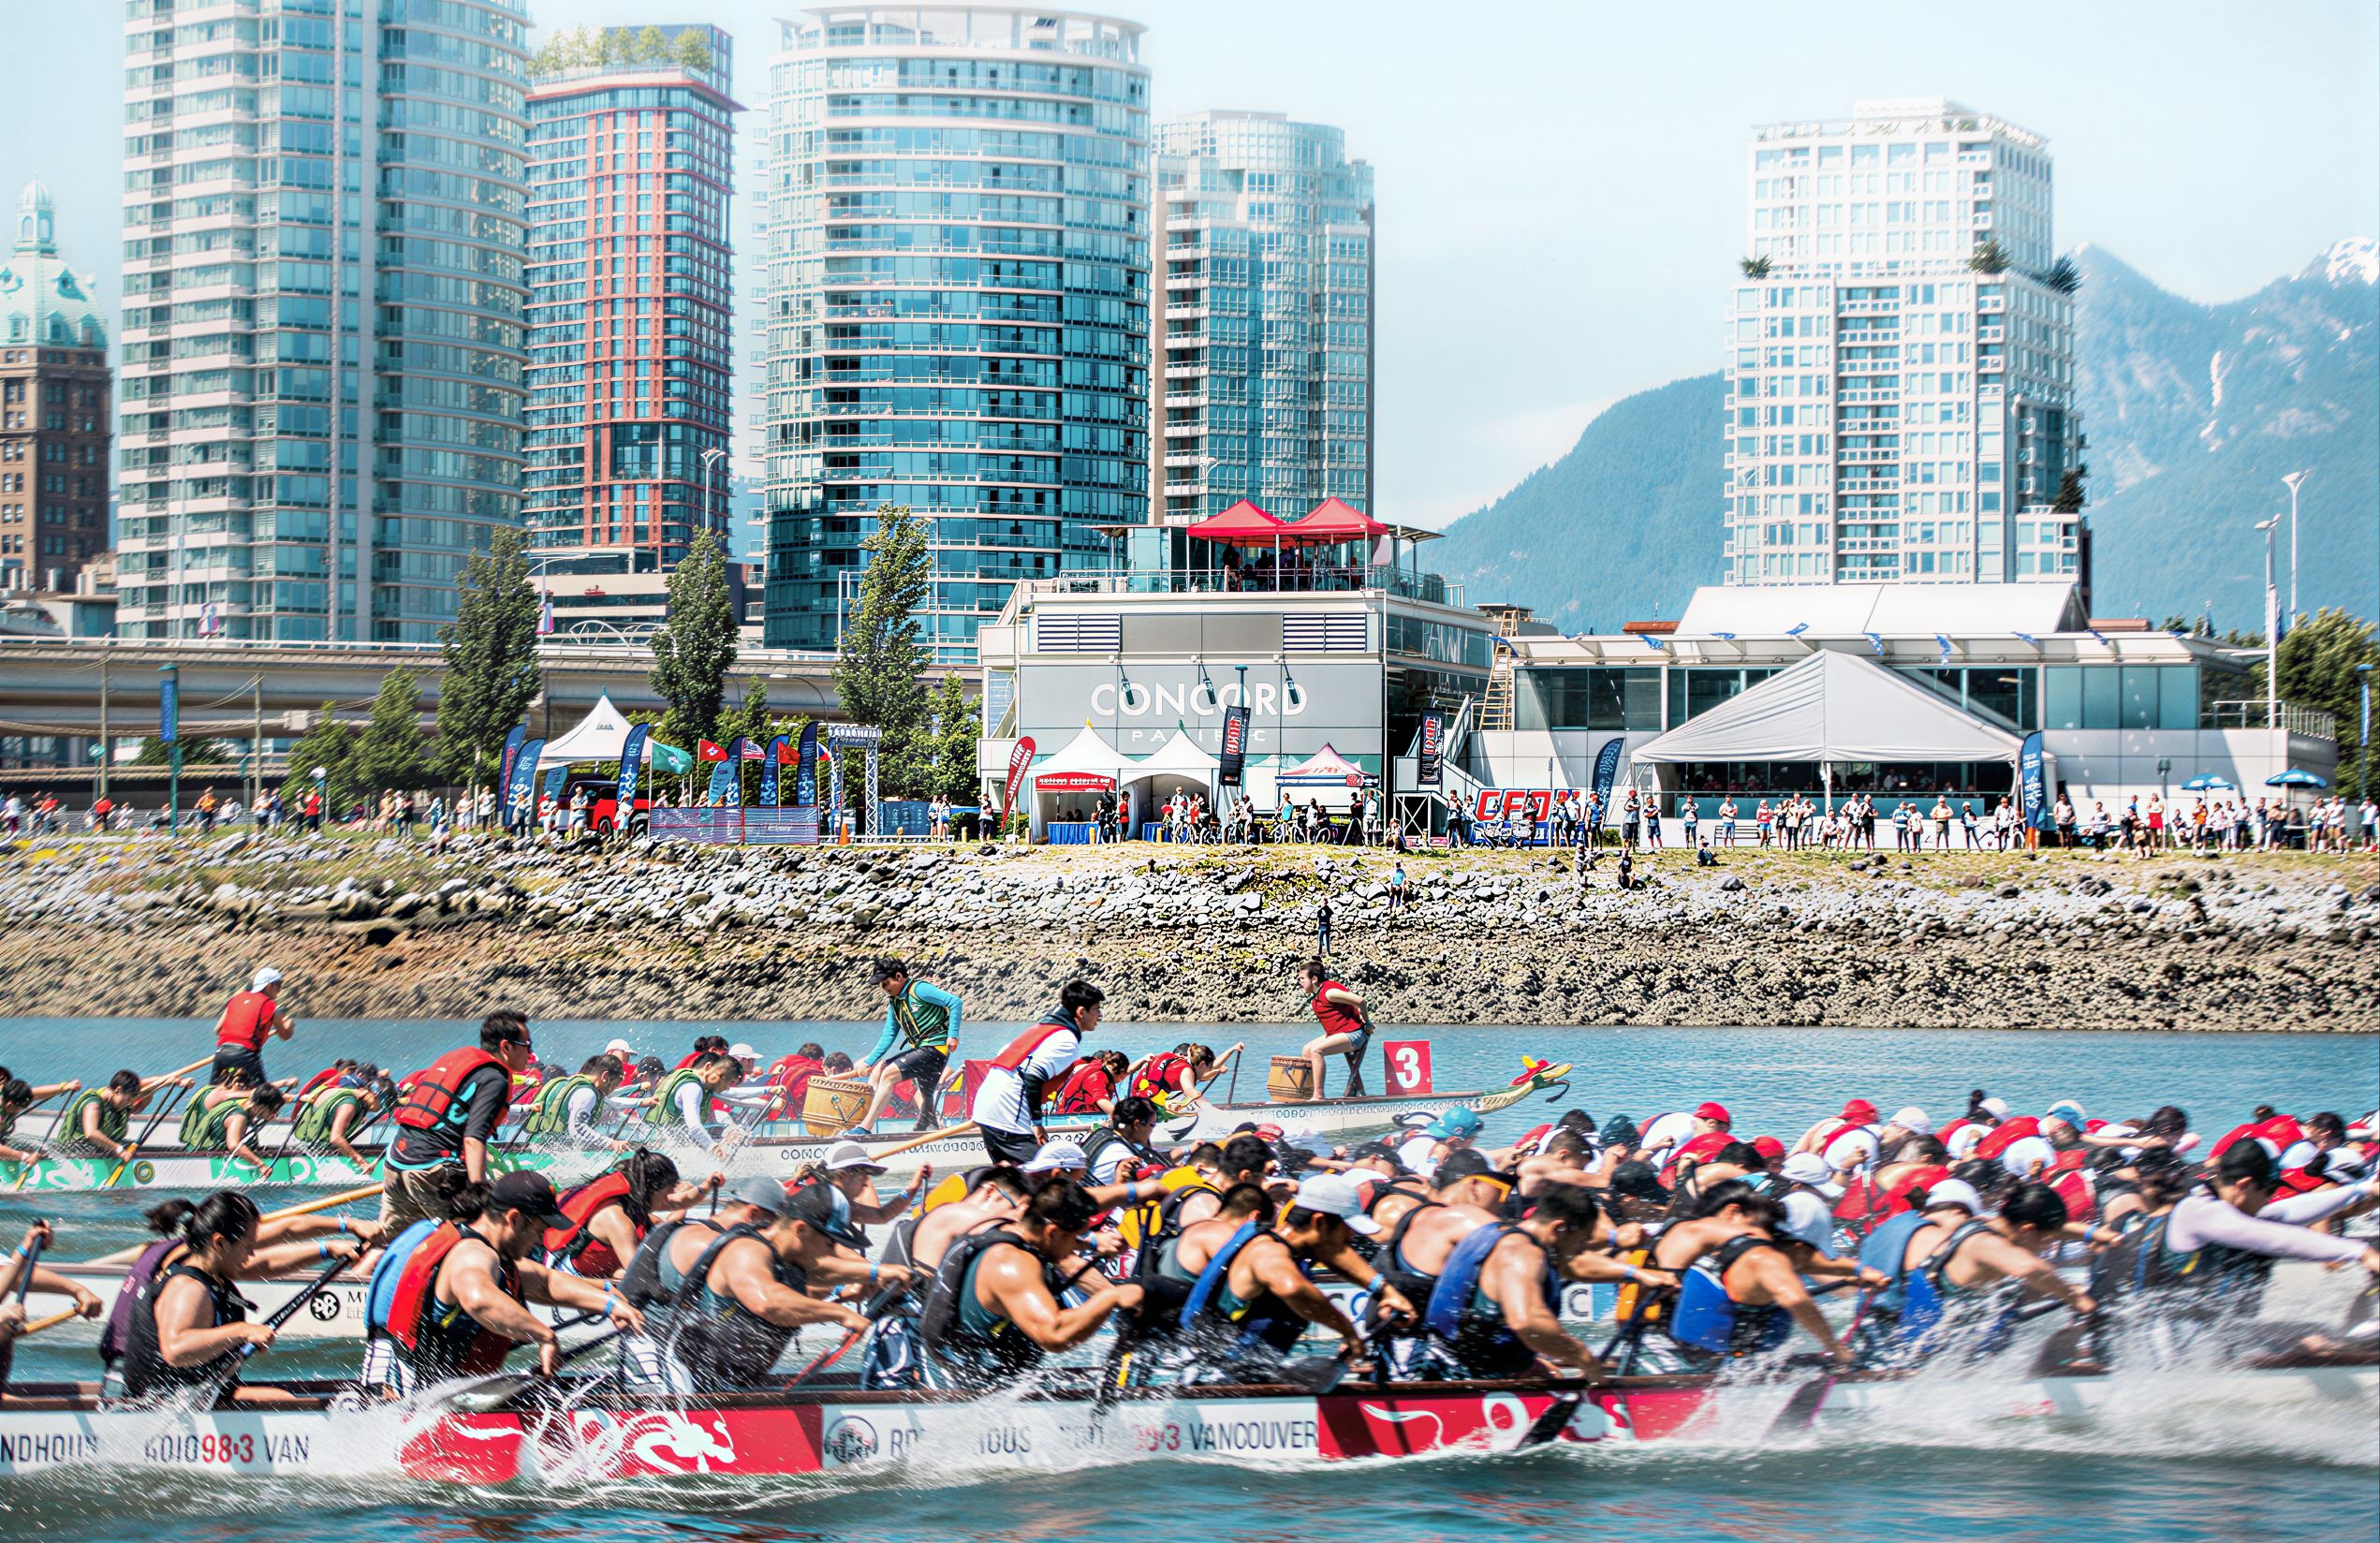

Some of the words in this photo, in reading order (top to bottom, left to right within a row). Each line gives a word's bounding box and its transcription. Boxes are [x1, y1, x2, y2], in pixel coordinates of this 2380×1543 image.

[1091, 683, 1308, 716] CONCORD
[1131, 729, 1267, 742] PAIFC
[1395, 1047, 1421, 1089] 3
[1189, 1420, 1319, 1451] VANCOUVER
